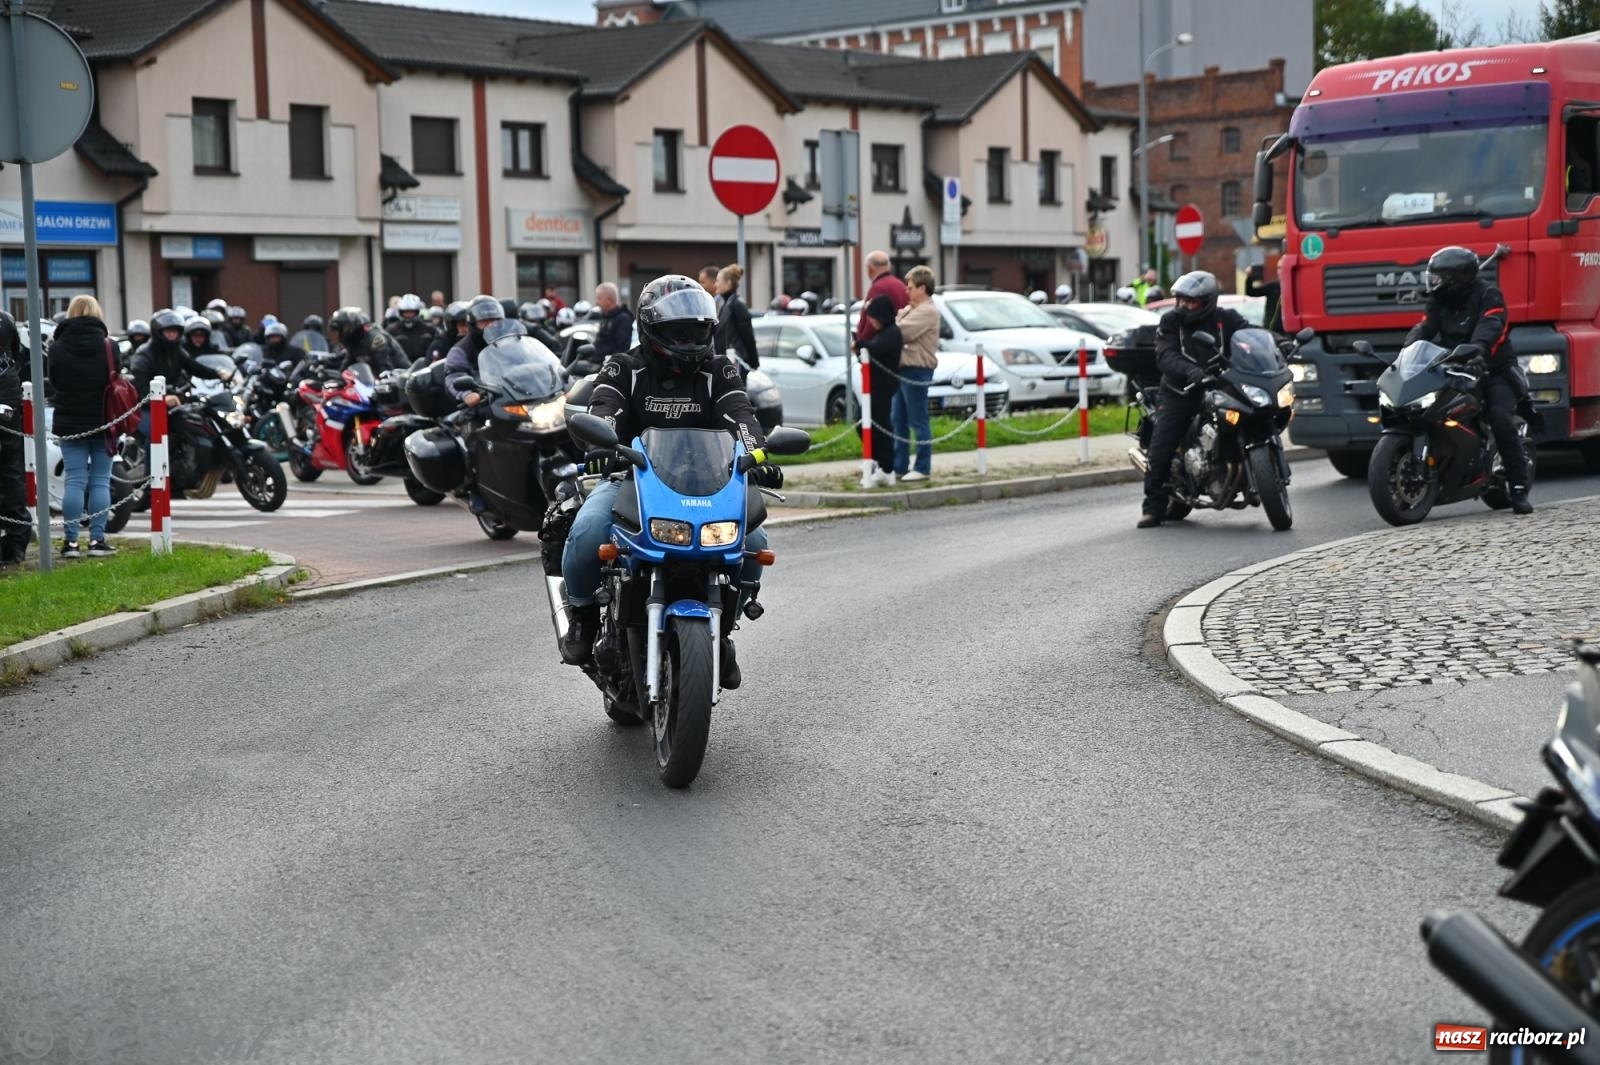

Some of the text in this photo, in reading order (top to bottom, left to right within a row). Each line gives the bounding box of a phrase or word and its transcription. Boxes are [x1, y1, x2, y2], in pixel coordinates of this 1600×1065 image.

[1372, 61, 1473, 91] PAKOS
[36, 215, 111, 229] SALON DRZWI
[526, 211, 581, 233] dentica
[680, 499, 713, 507] YAMAHA
